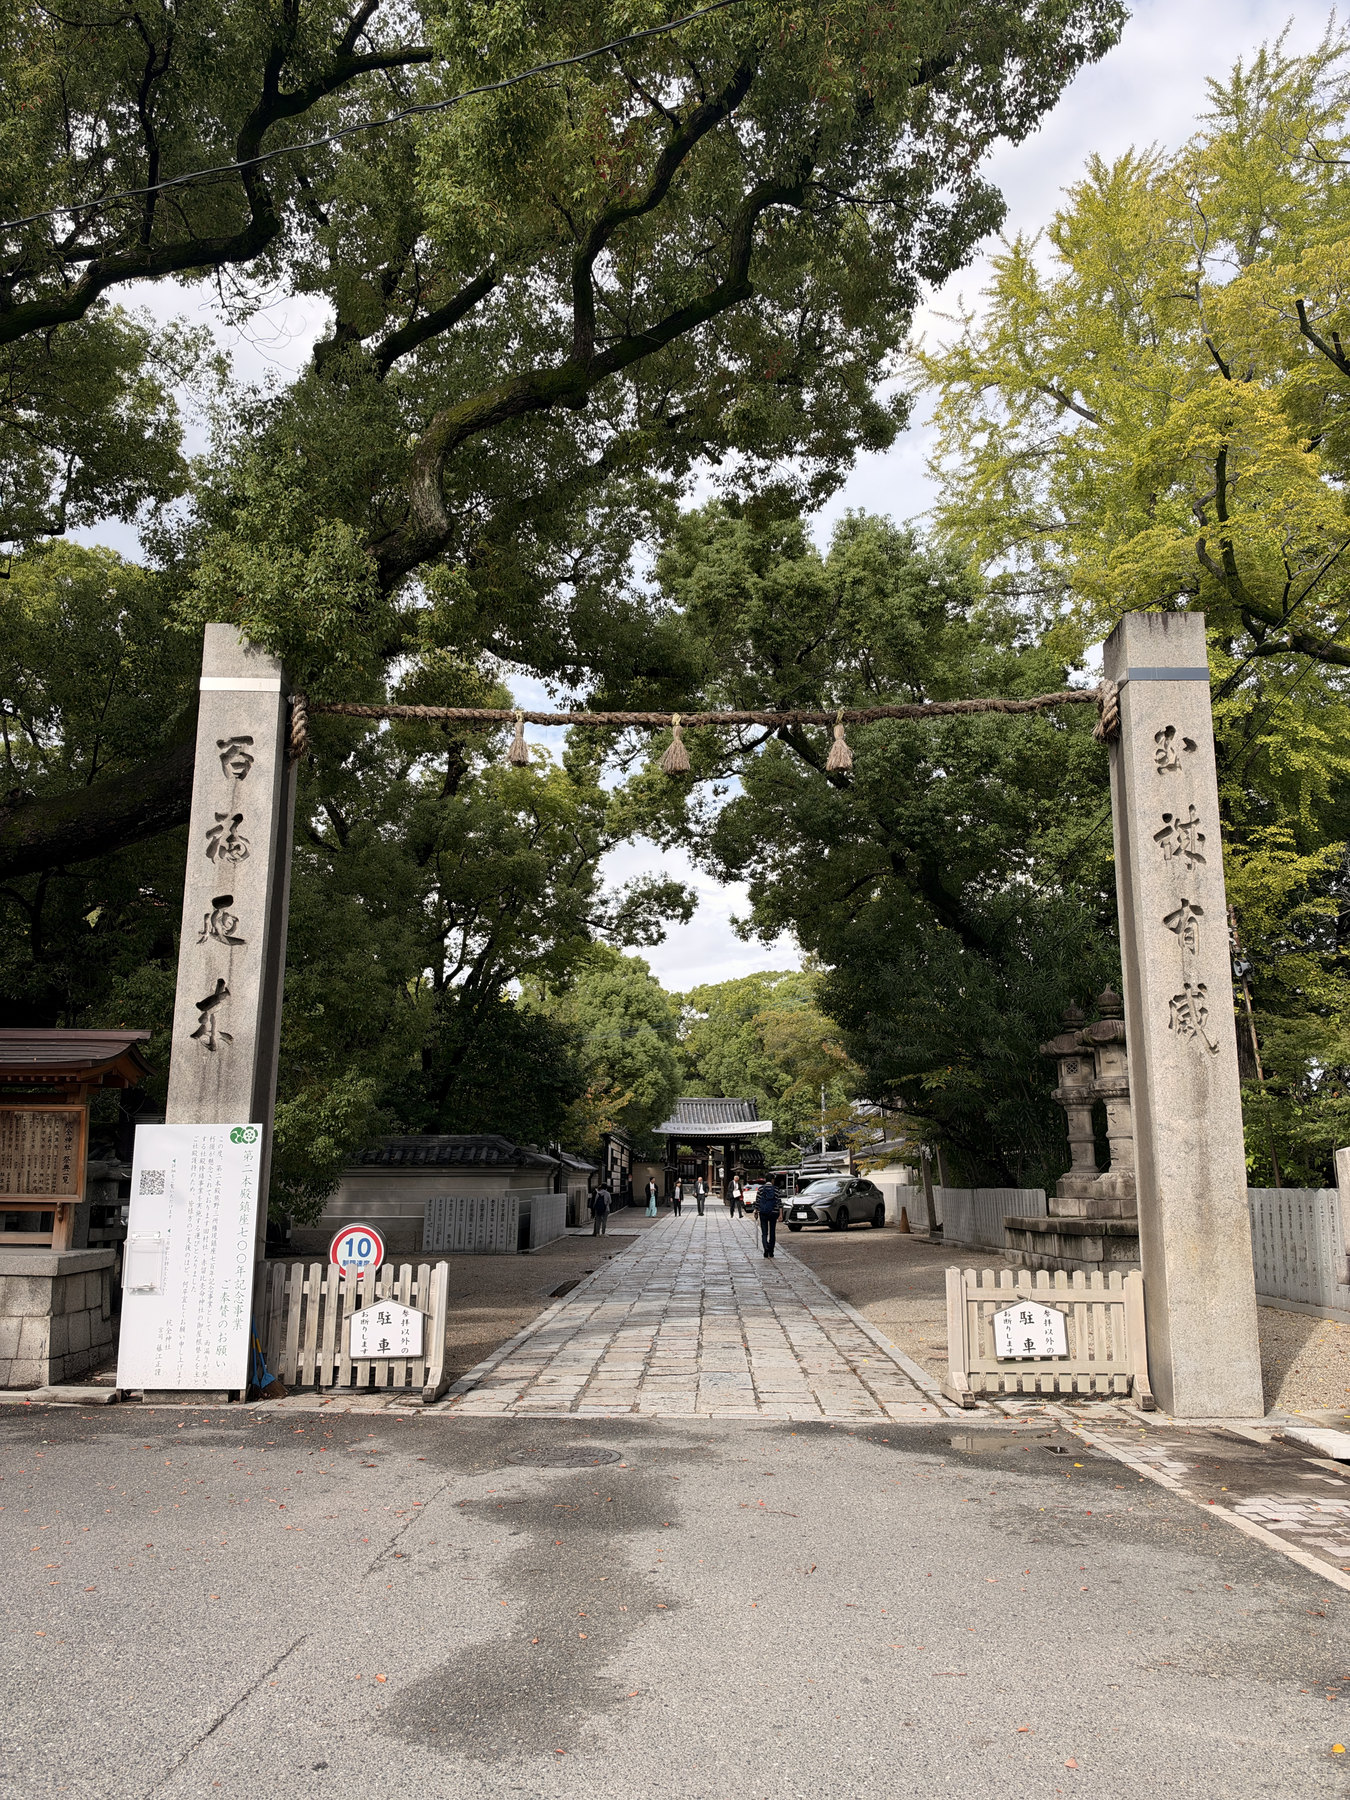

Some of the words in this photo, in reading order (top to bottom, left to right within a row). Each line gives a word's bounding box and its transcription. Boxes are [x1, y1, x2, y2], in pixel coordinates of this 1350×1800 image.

[345, 1237, 371, 1258] 10
[216, 1279, 231, 1368] ご奉賛のお願い
[360, 1311, 369, 1354] お断りします
[376, 1311, 393, 1354] 駐車
[401, 1310, 411, 1354] 参拝以外の
[1003, 1310, 1013, 1354] お断りします
[1019, 1311, 1036, 1353] 駐車
[1043, 1309, 1054, 1354] 参拝以外の
